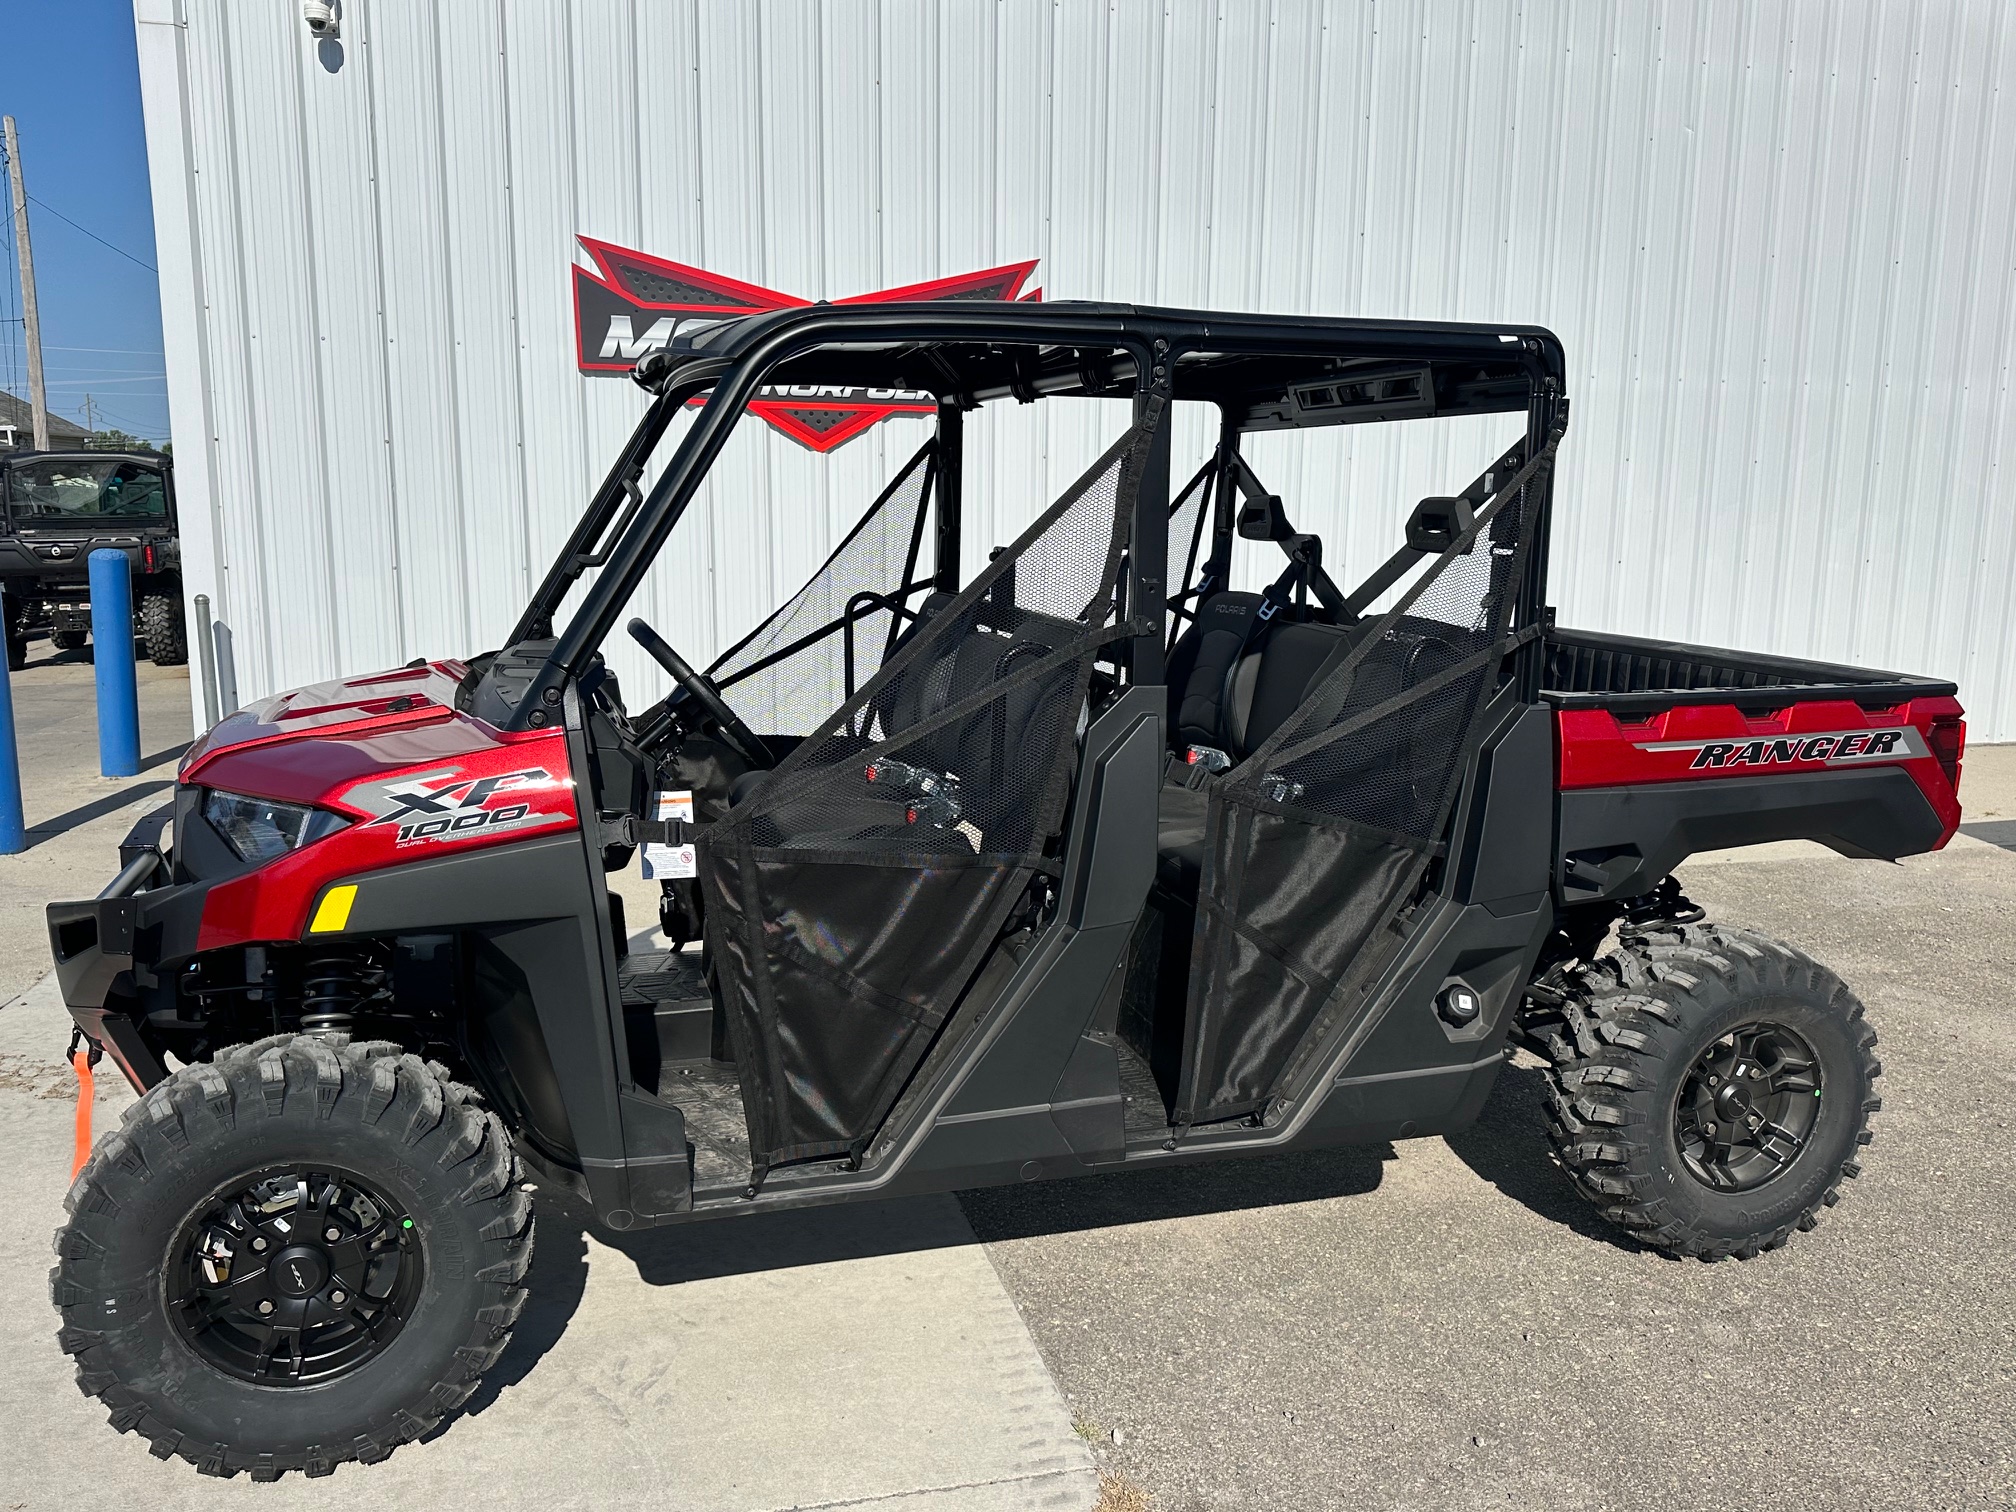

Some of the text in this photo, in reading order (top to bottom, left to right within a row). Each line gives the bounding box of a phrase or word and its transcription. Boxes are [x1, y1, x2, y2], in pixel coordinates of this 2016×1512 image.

[1215, 604, 1247, 615] POLARIS
[1689, 730, 1903, 770] RANGER
[354, 766, 554, 831] XP
[395, 803, 530, 844] 1000
[396, 821, 522, 849] DUAL OVERHEAD CAM
